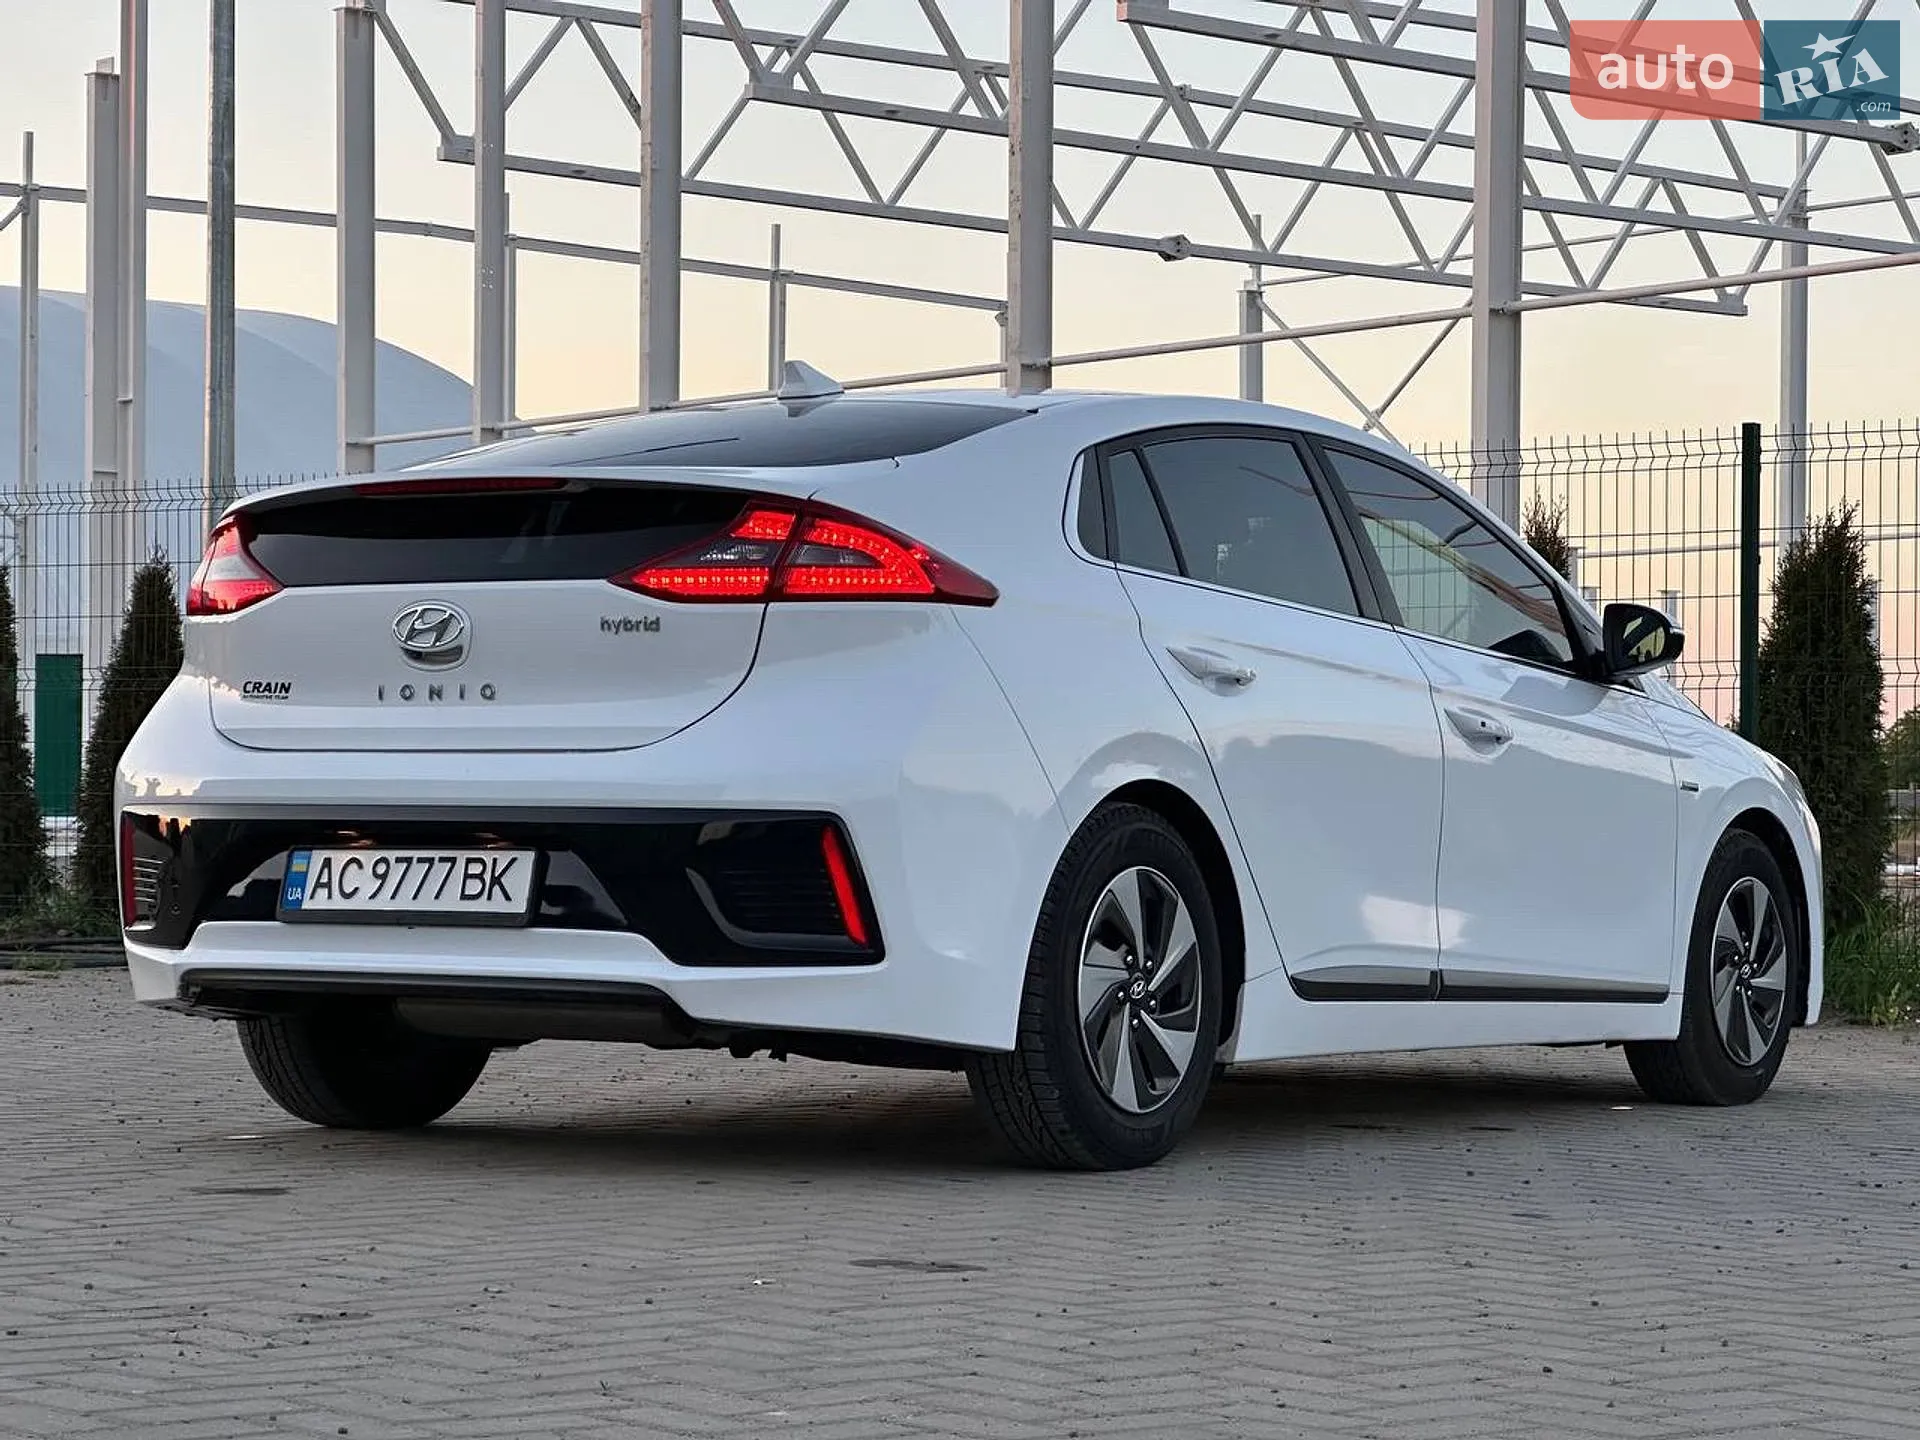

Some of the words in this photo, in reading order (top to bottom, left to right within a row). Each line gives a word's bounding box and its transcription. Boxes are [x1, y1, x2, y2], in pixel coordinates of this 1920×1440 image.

[600, 616, 660, 634] hybrid
[243, 680, 291, 694] CRAIN
[377, 684, 497, 701] IONIQ
[287, 887, 302, 900] UA
